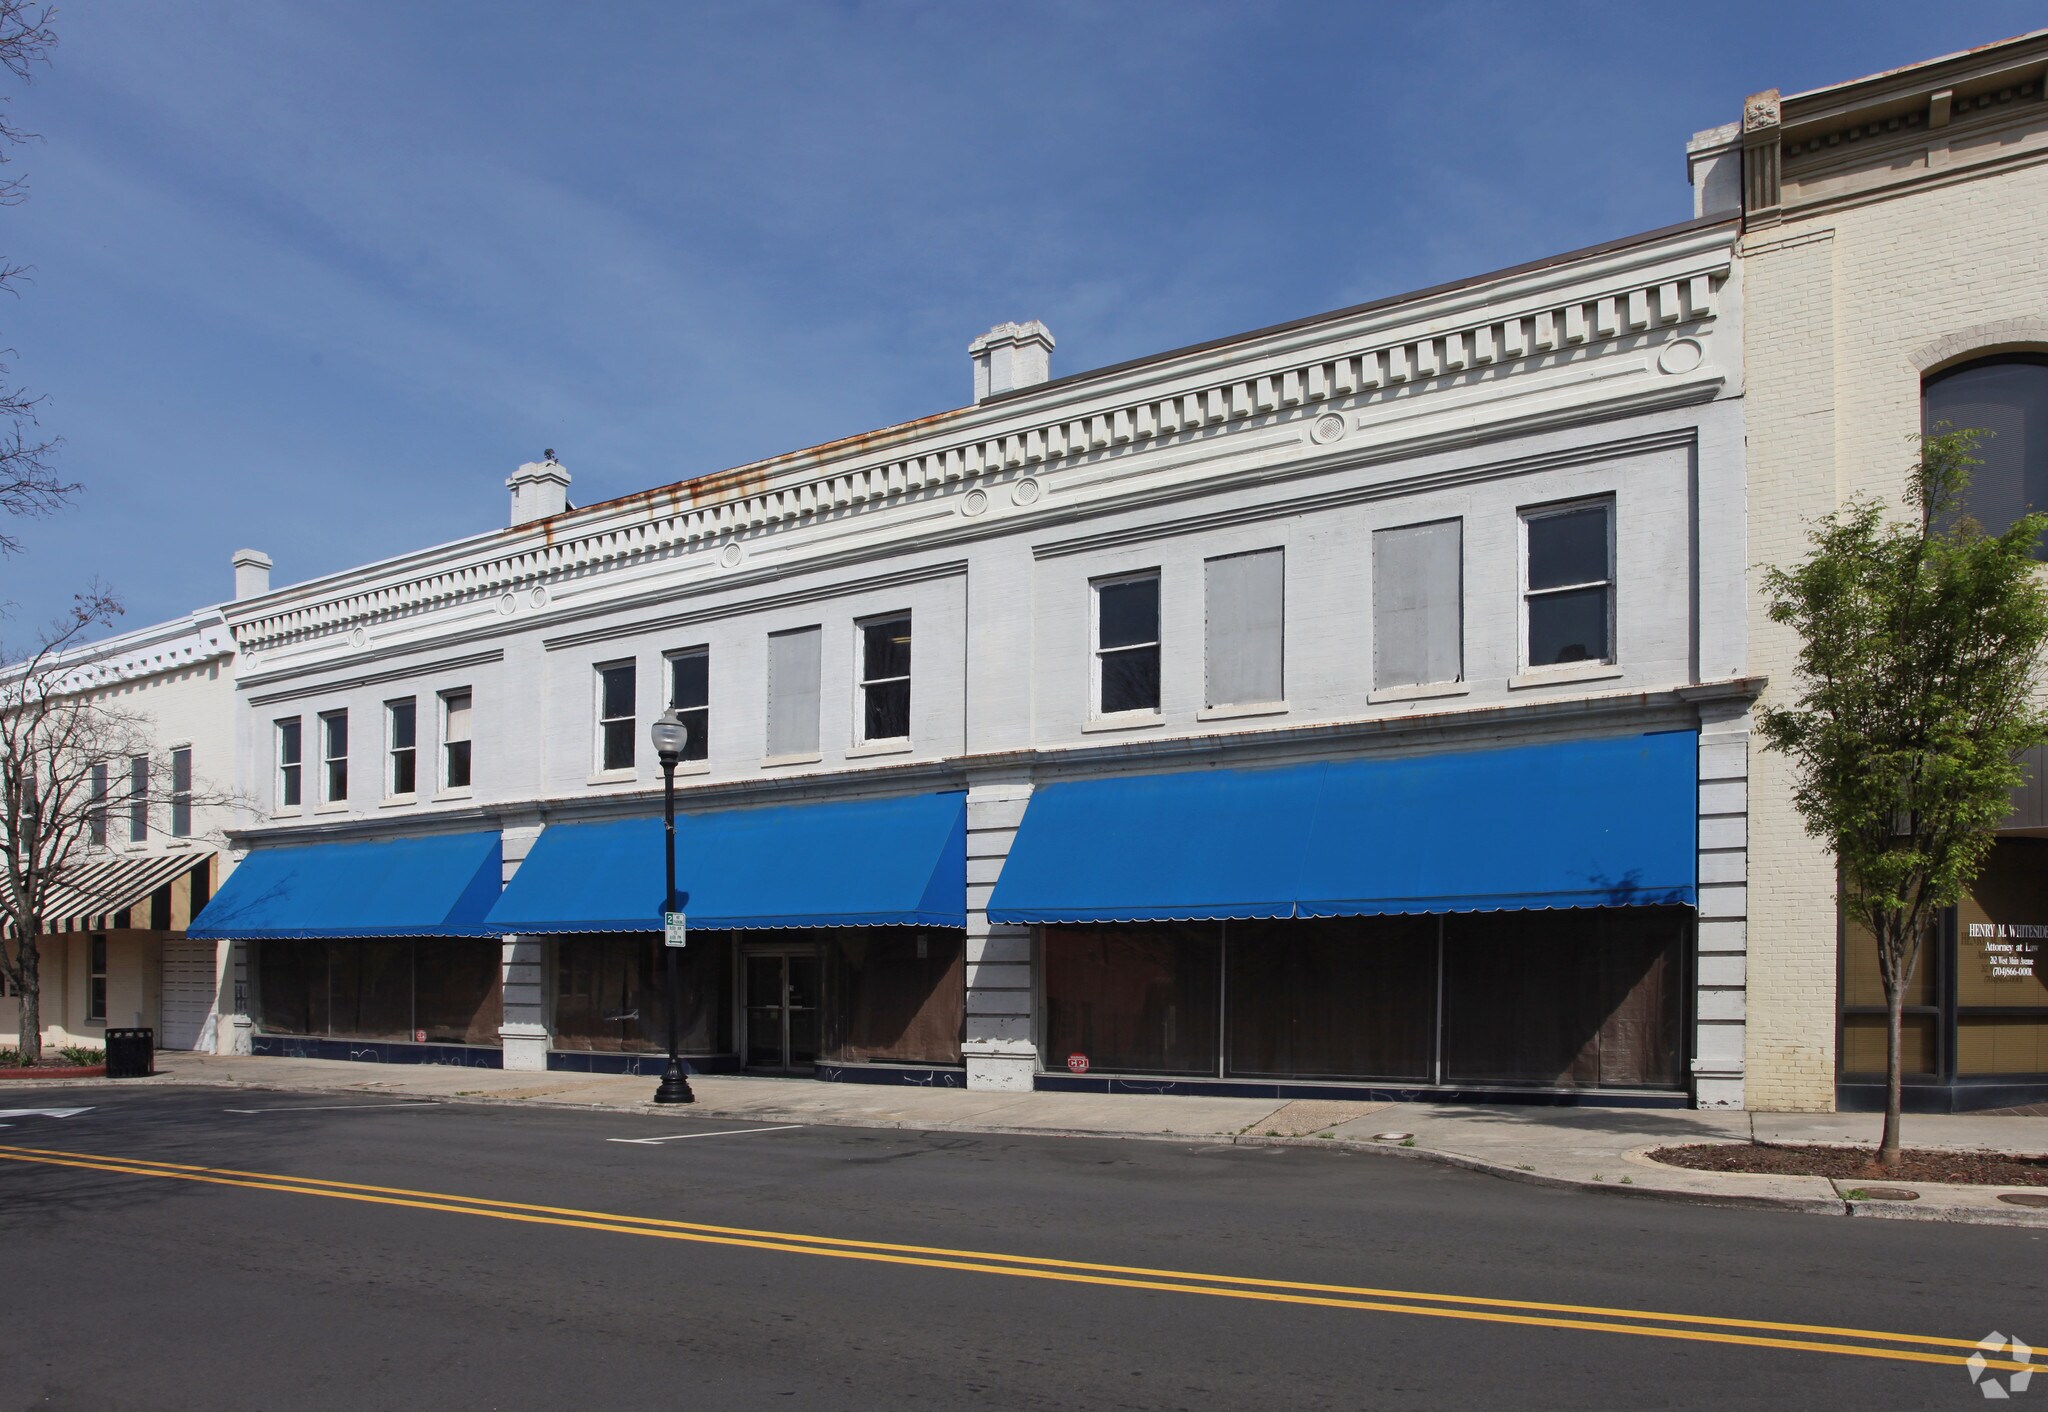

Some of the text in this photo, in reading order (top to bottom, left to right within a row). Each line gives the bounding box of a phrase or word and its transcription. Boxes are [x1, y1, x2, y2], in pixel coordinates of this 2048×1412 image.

[668, 916, 672, 924] 2
[1969, 924, 1995, 938] HENRY
[1998, 924, 2006, 938] M.
[1985, 942, 2013, 954] Attorney
[2025, 942, 2039, 952] Law
[1998, 956, 2008, 965] West
[2009, 956, 2019, 965] Main
[1068, 1059, 1088, 1068] CPI
